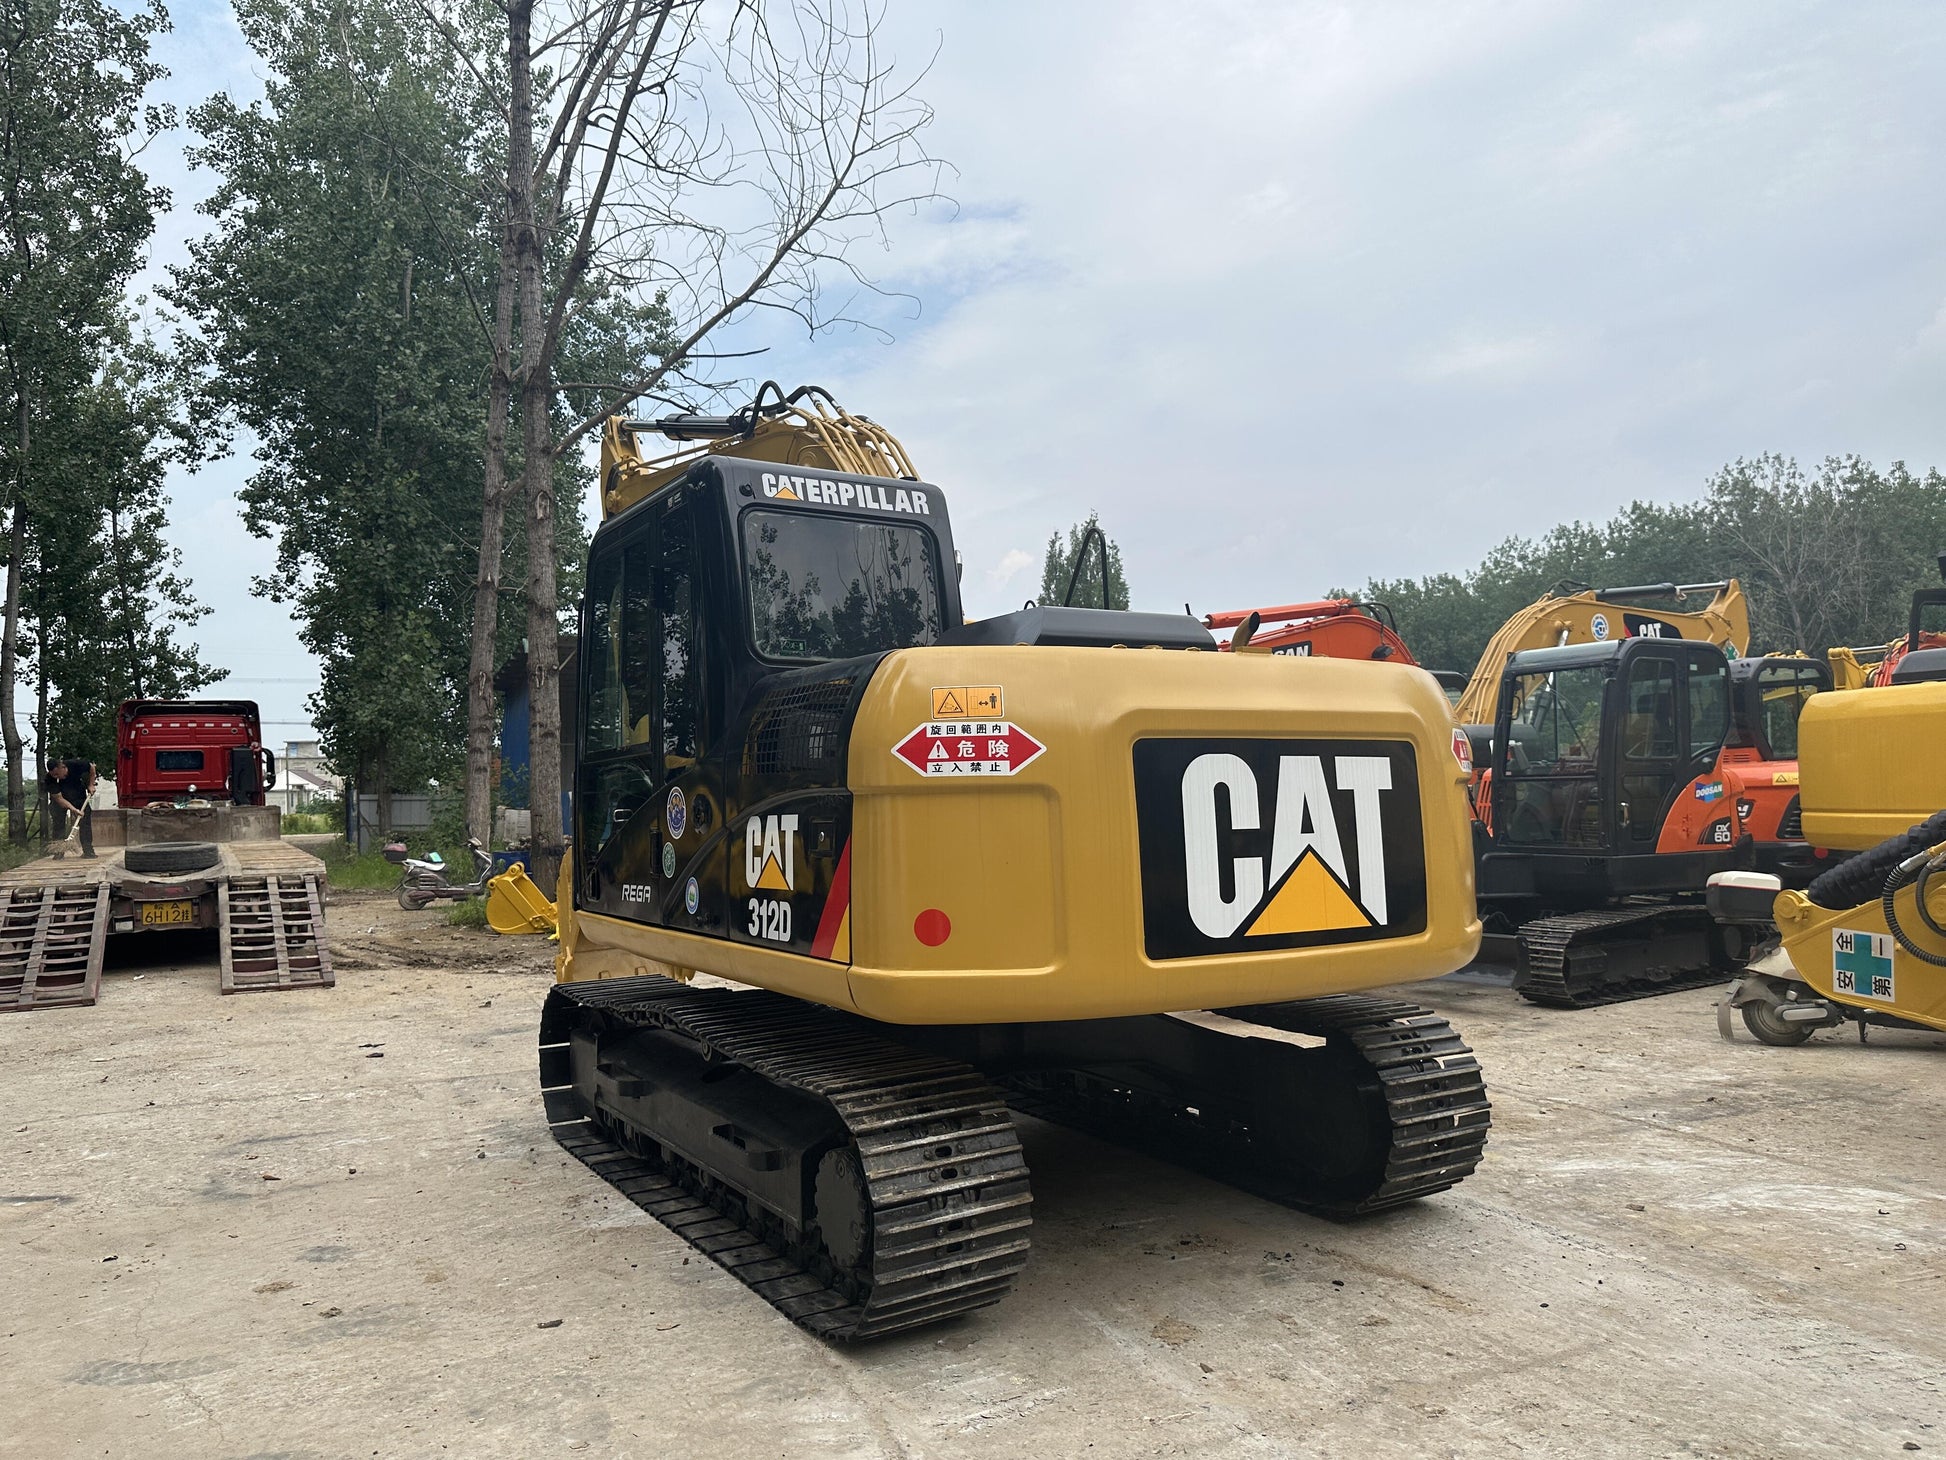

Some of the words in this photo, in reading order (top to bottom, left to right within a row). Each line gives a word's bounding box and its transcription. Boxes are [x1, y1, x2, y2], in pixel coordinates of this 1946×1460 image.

[761, 472, 930, 515] CATERPILLAR
[1639, 622, 1661, 638] CAT
[930, 724, 1002, 735] 旋回範囲内
[957, 739, 1010, 758] 危険
[931, 761, 1002, 773] 立入禁止
[1695, 784, 1723, 798] DOOSAN
[1714, 831, 1731, 842] 60
[745, 814, 799, 891] CAT
[1181, 753, 1392, 939] CAT
[748, 898, 792, 942] 312D
